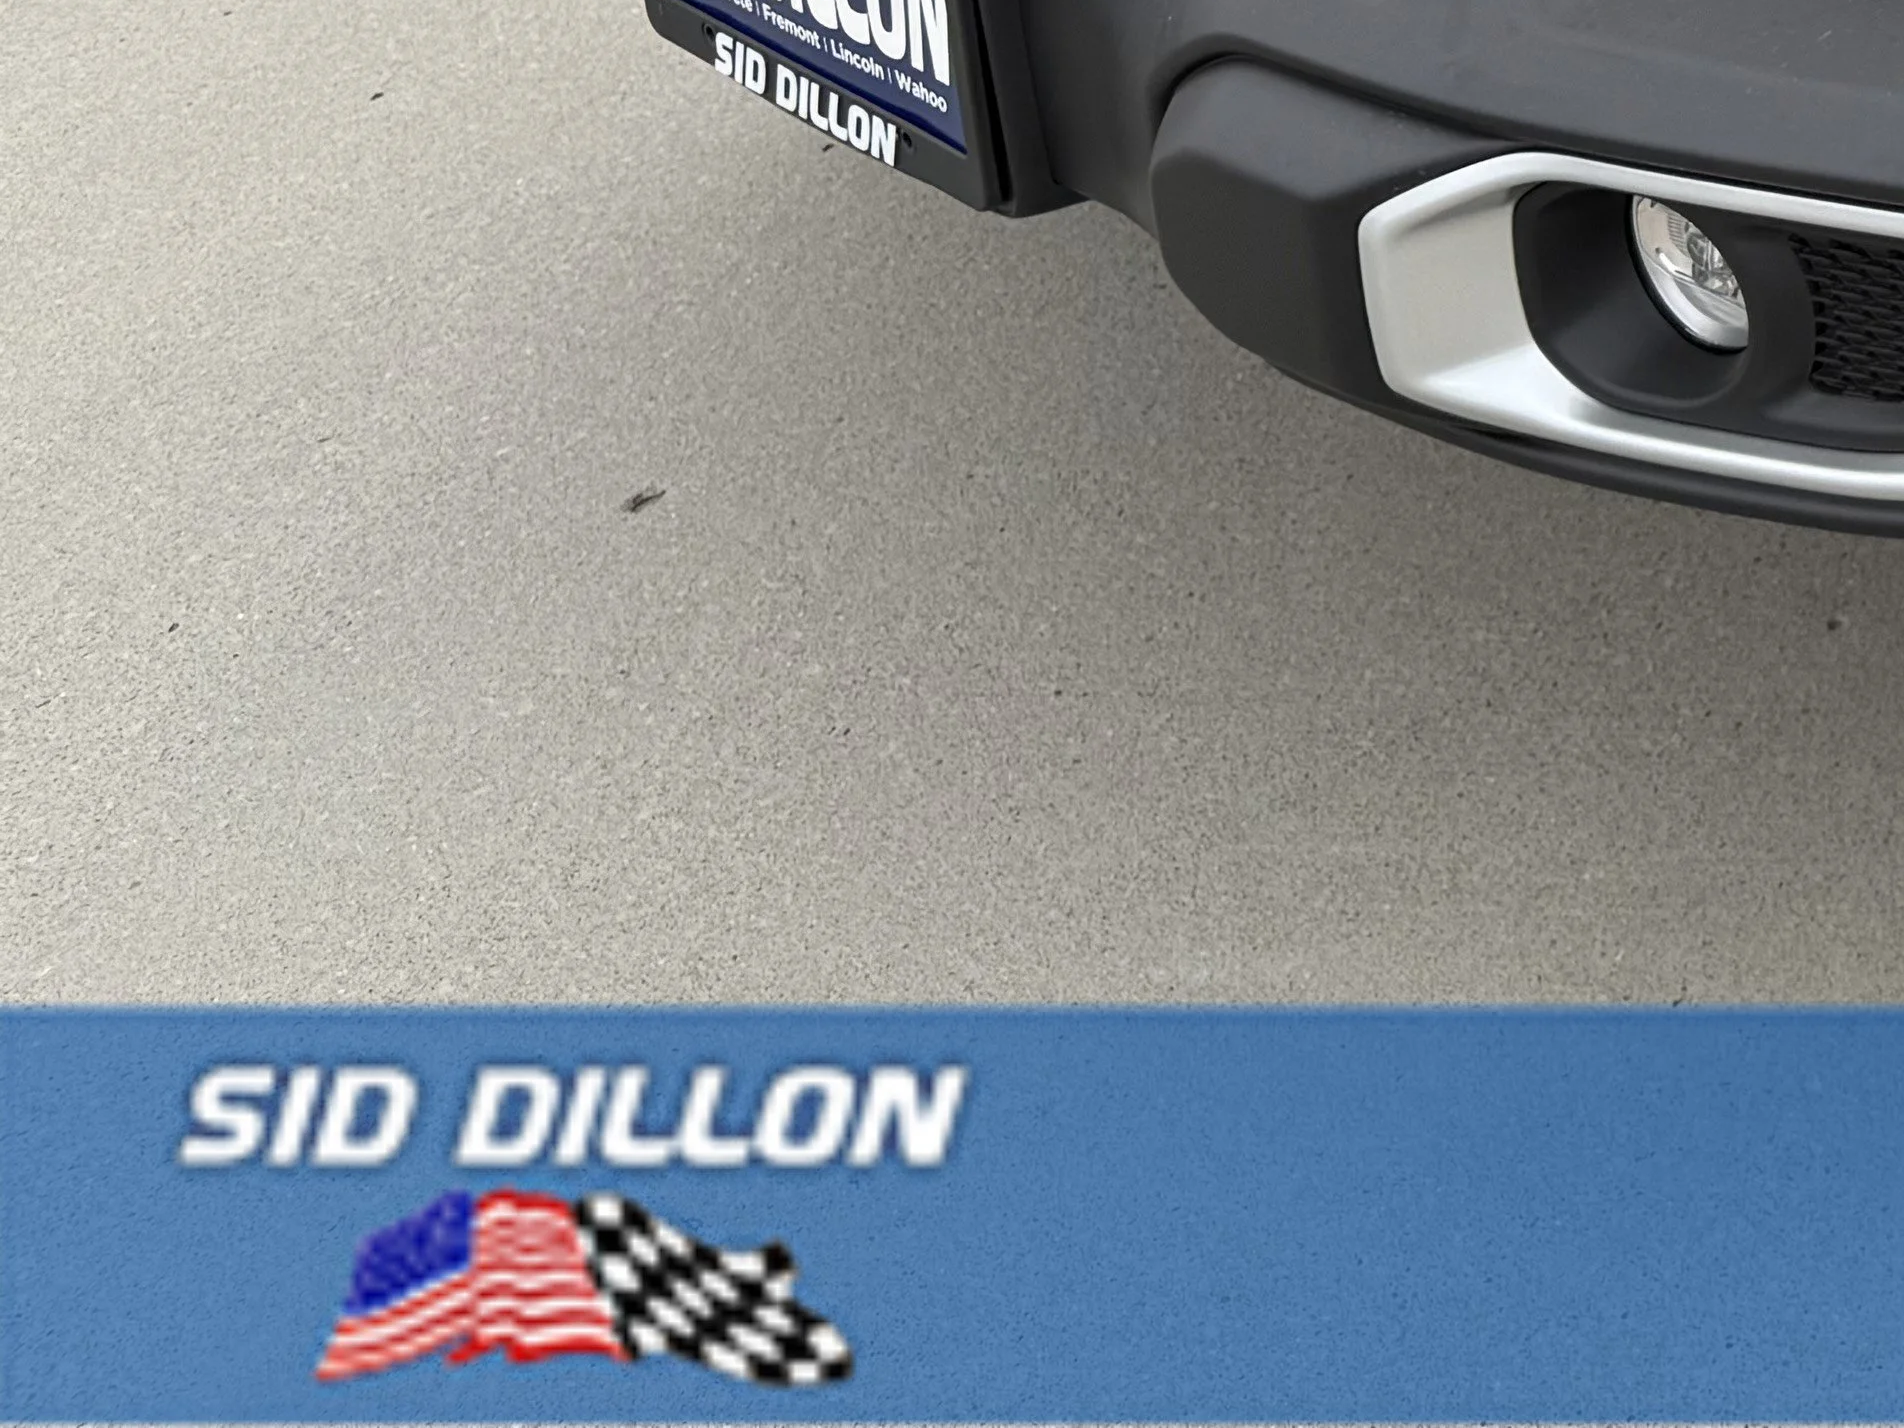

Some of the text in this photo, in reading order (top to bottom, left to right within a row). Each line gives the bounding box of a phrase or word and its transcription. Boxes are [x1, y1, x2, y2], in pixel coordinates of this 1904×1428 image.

[714, 31, 897, 168] SID DILLON
[763, 2, 821, 50] Fremont
[830, 38, 885, 81] Lincoln
[894, 68, 948, 114] Wahoo
